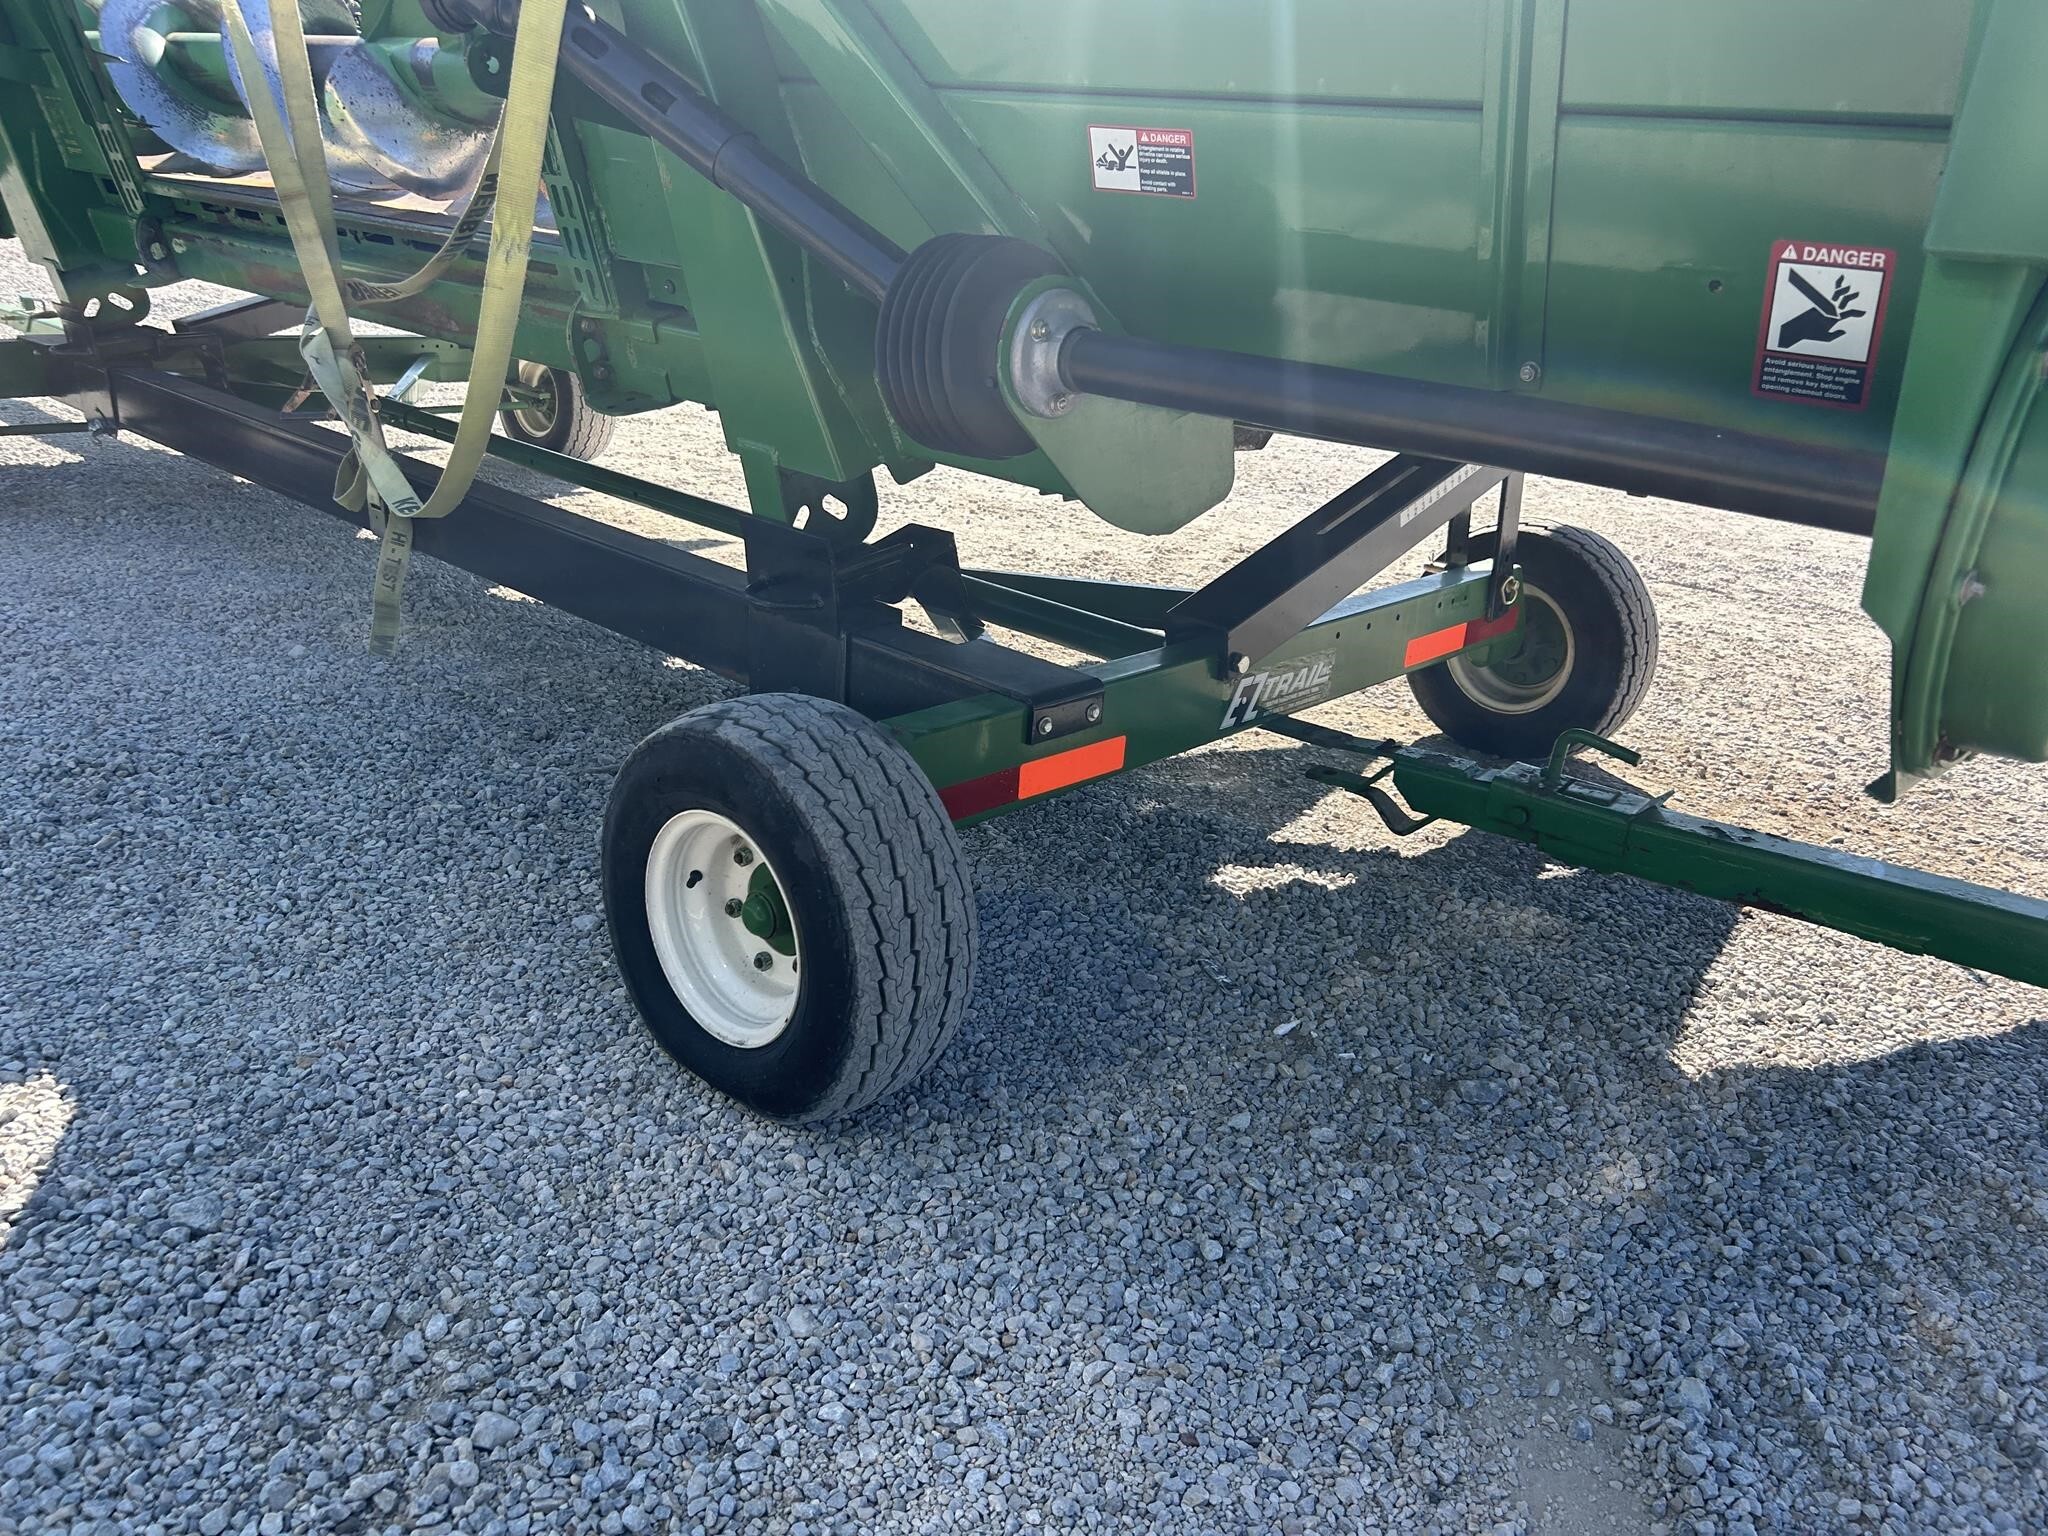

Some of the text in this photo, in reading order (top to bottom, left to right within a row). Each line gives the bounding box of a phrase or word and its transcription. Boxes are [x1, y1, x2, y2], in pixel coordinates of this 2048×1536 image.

[1150, 133, 1187, 144] DANGER
[1802, 246, 1886, 268] DANGER
[1765, 357, 1857, 375] Avoid serious injury from
[1762, 374, 1844, 391] and remove key before
[1764, 366, 1860, 385] entanglement. Stop engine
[1761, 383, 1848, 400] opening cleanout doors.
[1262, 661, 1331, 702] TRAIL
